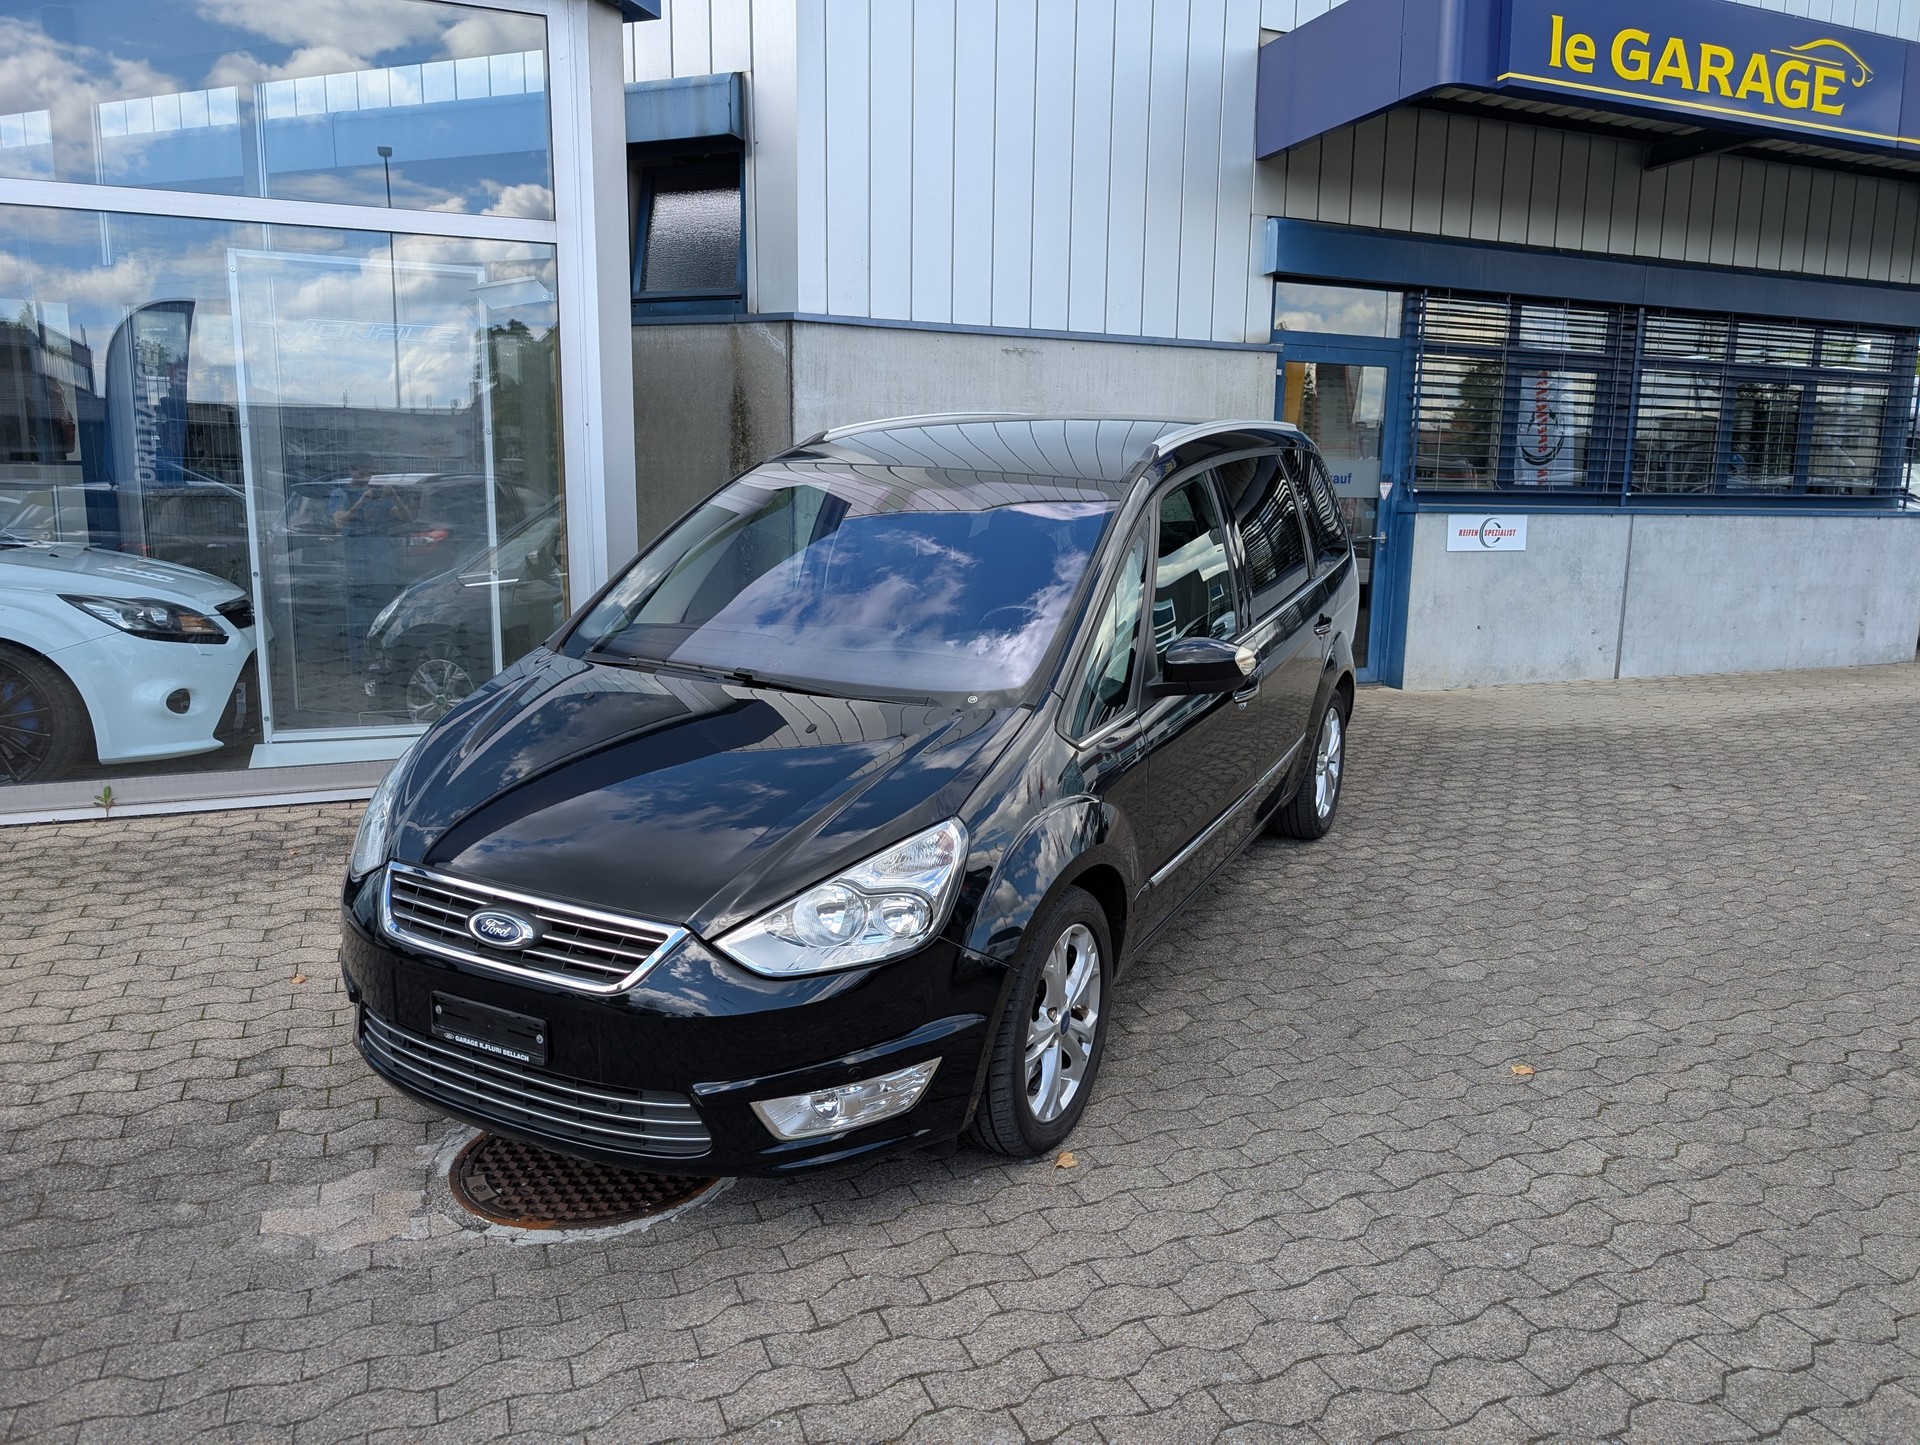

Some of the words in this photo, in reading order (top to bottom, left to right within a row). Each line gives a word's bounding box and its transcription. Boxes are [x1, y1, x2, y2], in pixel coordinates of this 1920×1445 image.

[1549, 14, 1596, 74] le
[1610, 28, 1846, 117] GARAGE
[1330, 472, 1353, 484] auf
[1458, 528, 1479, 537] REIFEN
[1484, 528, 1517, 537] SPEZIALIST
[480, 918, 512, 938] Ford
[455, 1035, 479, 1048] GARAGE
[503, 1049, 530, 1062] BELLACH
